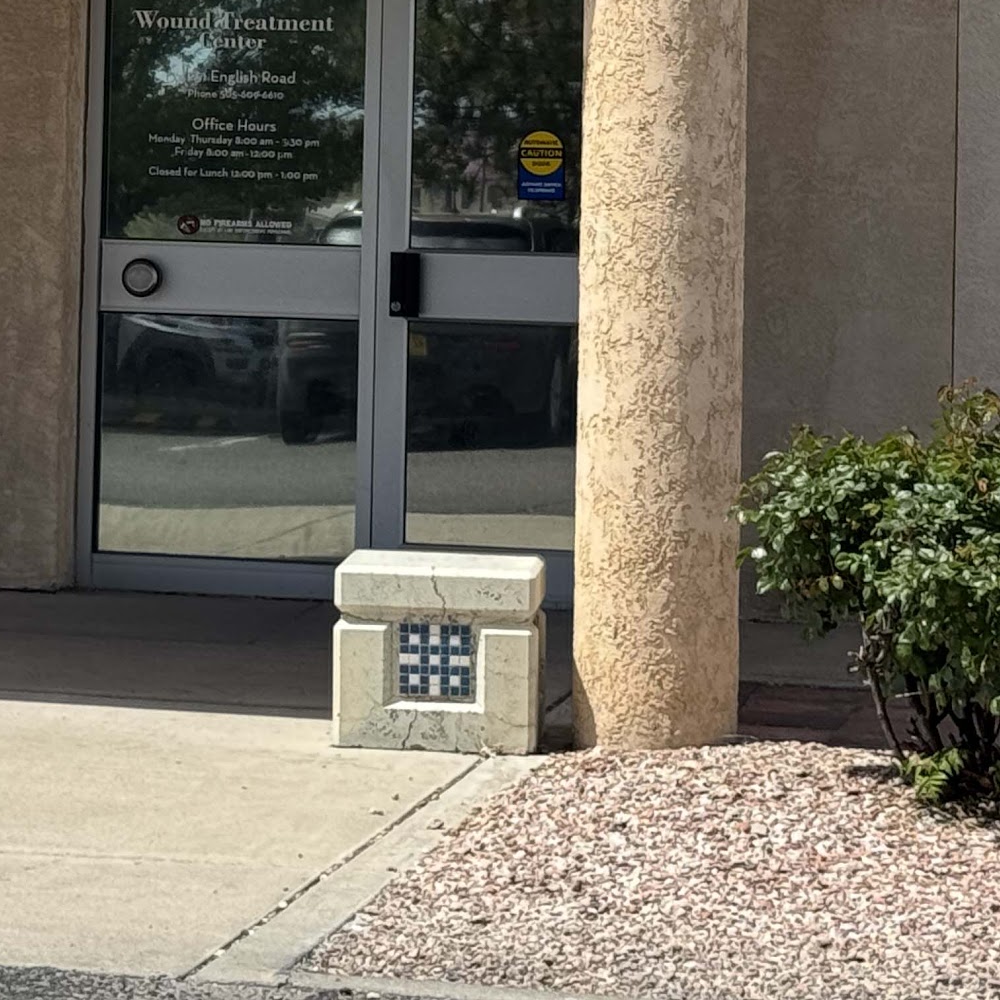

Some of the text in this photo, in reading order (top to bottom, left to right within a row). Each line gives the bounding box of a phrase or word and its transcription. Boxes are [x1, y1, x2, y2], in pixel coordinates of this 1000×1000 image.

[133, 10, 335, 32] Wound Treatment
[200, 33, 267, 49] Center
[210, 69, 259, 86] English
[261, 70, 297, 84] Road
[187, 88, 218, 98] Phone
[191, 117, 277, 132] Office Hours
[148, 133, 186, 145] Monday
[190, 134, 233, 147] Thursday
[234, 136, 258, 145] 8:00
[259, 138, 274, 146] am
[304, 140, 320, 149] pm
[230, 150, 244, 158] am
[250, 150, 276, 159] 12:00
[277, 152, 293, 160] pm
[520, 149, 562, 157] CAUTION
[148, 166, 182, 177] Closed
[183, 167, 198, 177] for
[199, 168, 229, 178] Lunch
[230, 170, 256, 179] 12:00
[257, 171, 273, 181] pm
[302, 172, 319, 182] pm
[255, 221, 292, 229] ALLOWED
